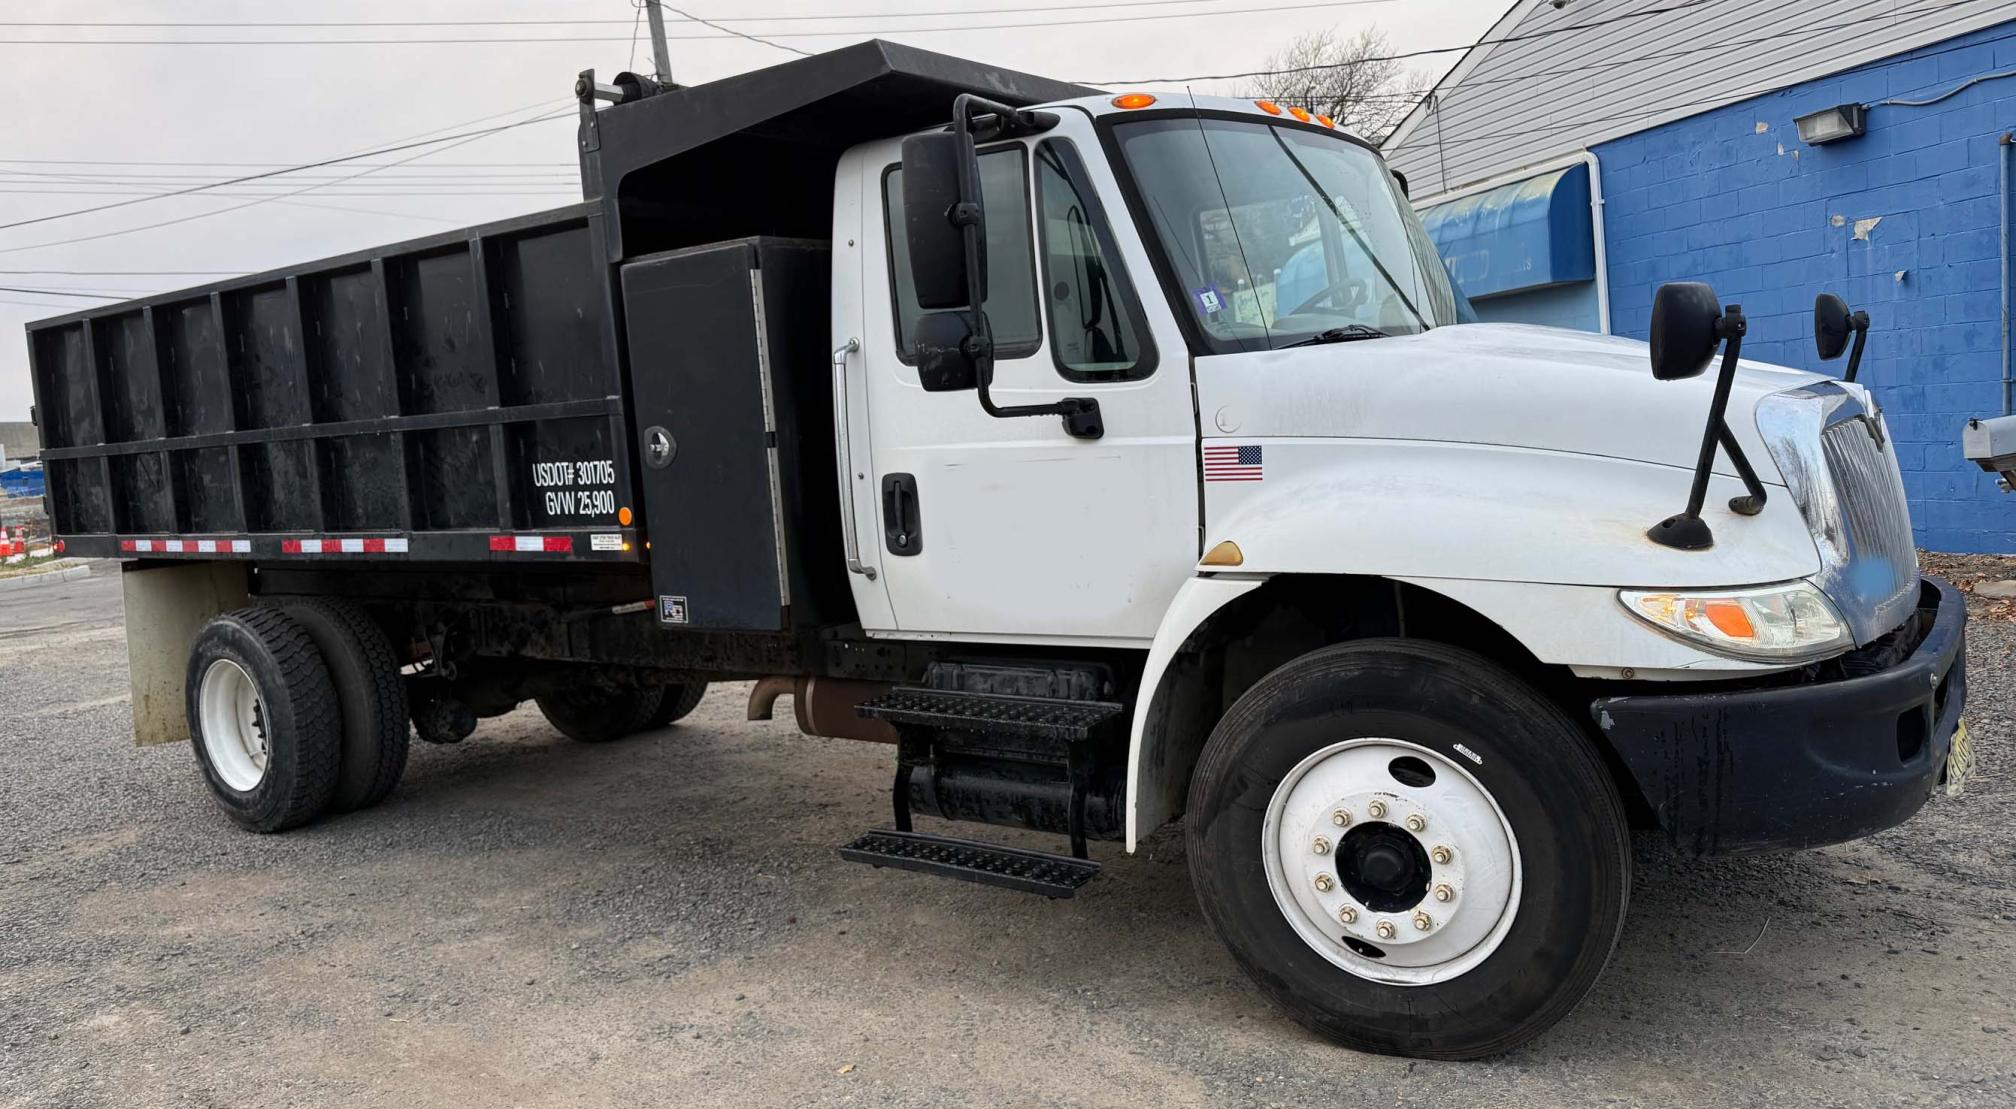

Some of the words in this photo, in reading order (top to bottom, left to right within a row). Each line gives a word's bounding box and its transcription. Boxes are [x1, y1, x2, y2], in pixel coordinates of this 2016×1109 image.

[1206, 295, 1213, 304] 1
[532, 462, 574, 487] USDOT#
[576, 460, 615, 485] 301705
[545, 491, 575, 515] GVW
[577, 490, 615, 518] 25,900
